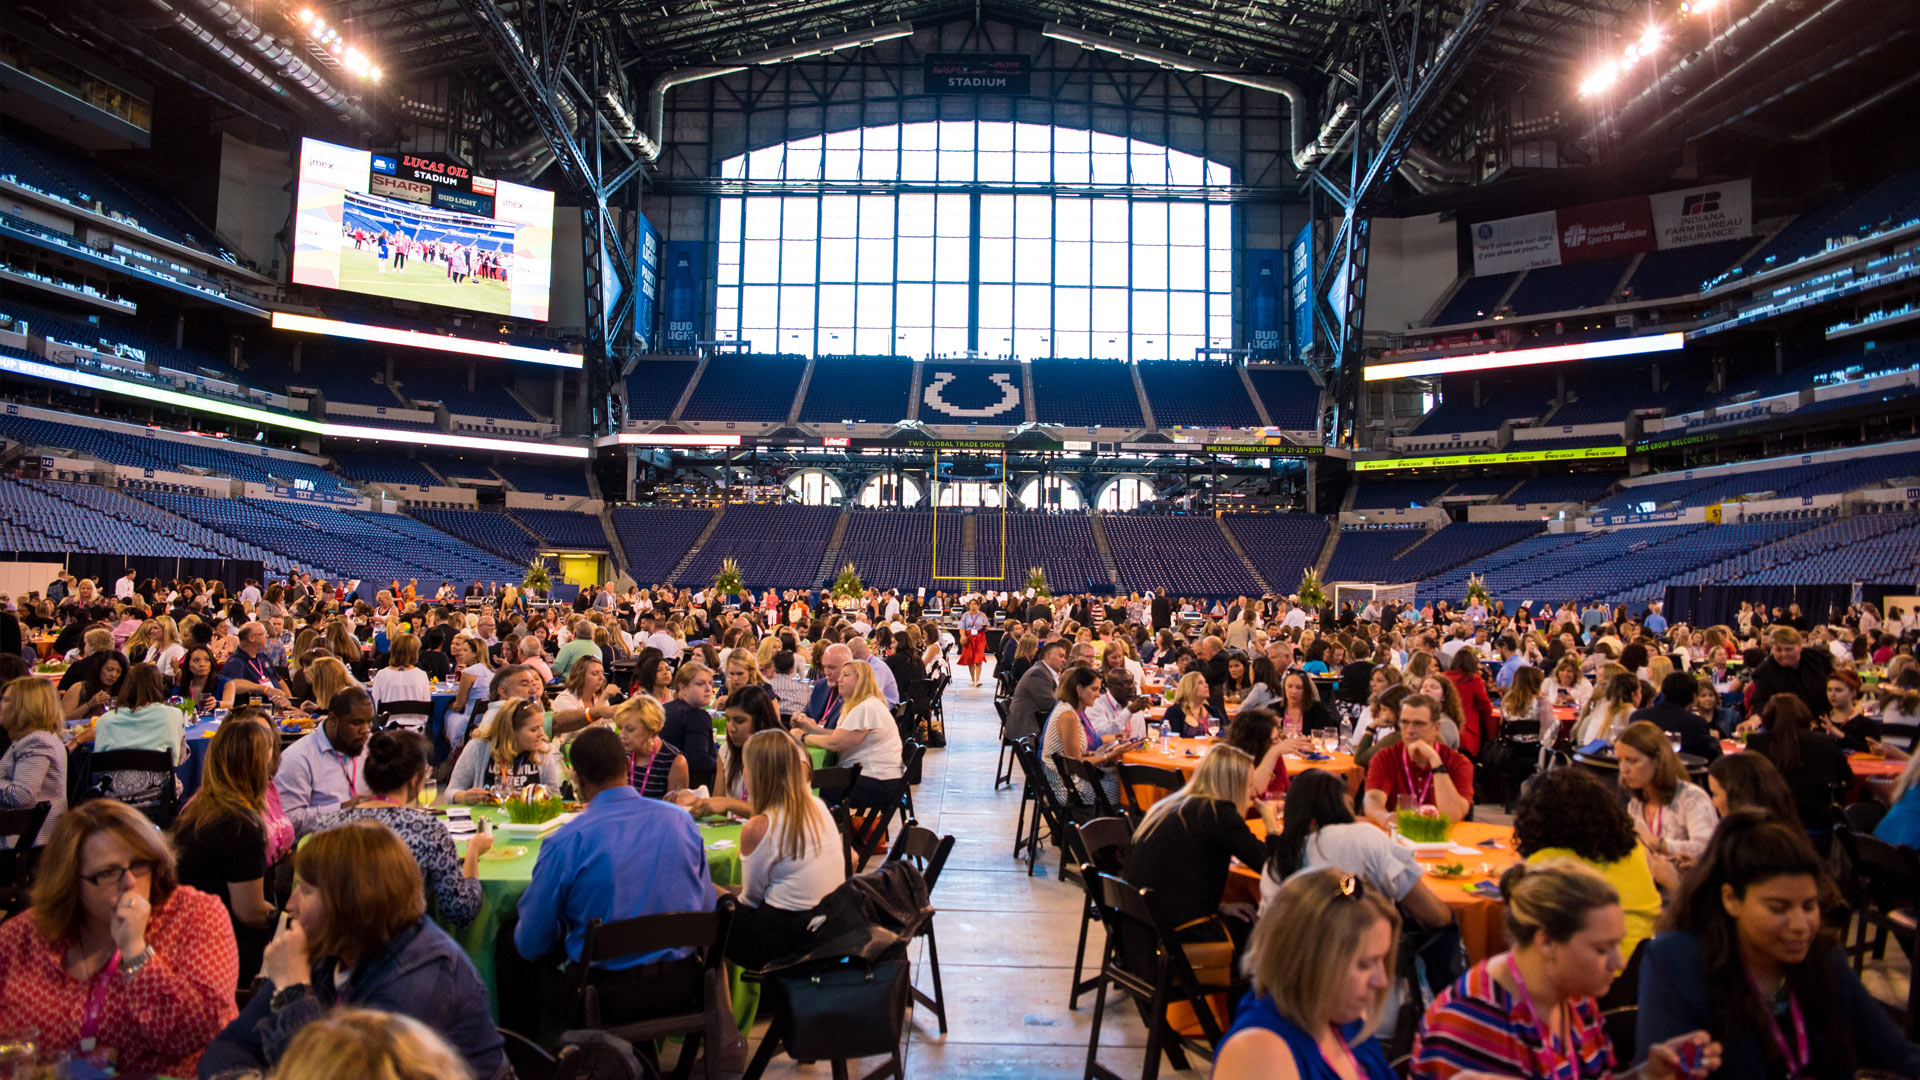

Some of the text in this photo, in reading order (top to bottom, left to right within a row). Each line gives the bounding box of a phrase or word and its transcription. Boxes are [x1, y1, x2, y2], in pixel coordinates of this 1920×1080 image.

[948, 77, 1006, 87] STADIUM
[403, 155, 469, 179] LUCAS OIL
[373, 175, 431, 194] SHARP
[414, 170, 458, 186] STADIUM
[438, 194, 454, 203] BUD
[455, 197, 477, 207] LIGHT
[1681, 212, 1725, 226] INDIANA
[1588, 222, 1625, 236] Methodist
[1665, 218, 1743, 237] FARM BUREAU
[1672, 227, 1736, 243] INSURANCE
[1586, 229, 1648, 246] Sports Medicine
[670, 321, 693, 331] BUD
[1255, 330, 1278, 340] BUD
[18, 359, 69, 381] WELCOMES
[71, 372, 90, 384] YOU
[1635, 443, 1650, 453] IMEX
[1650, 440, 1670, 450] GROUP
[1671, 435, 1703, 447] WELCOMES
[1705, 433, 1718, 441] YOU
[295, 490, 312, 500] TEXT
[1611, 515, 1626, 524] TEXT
